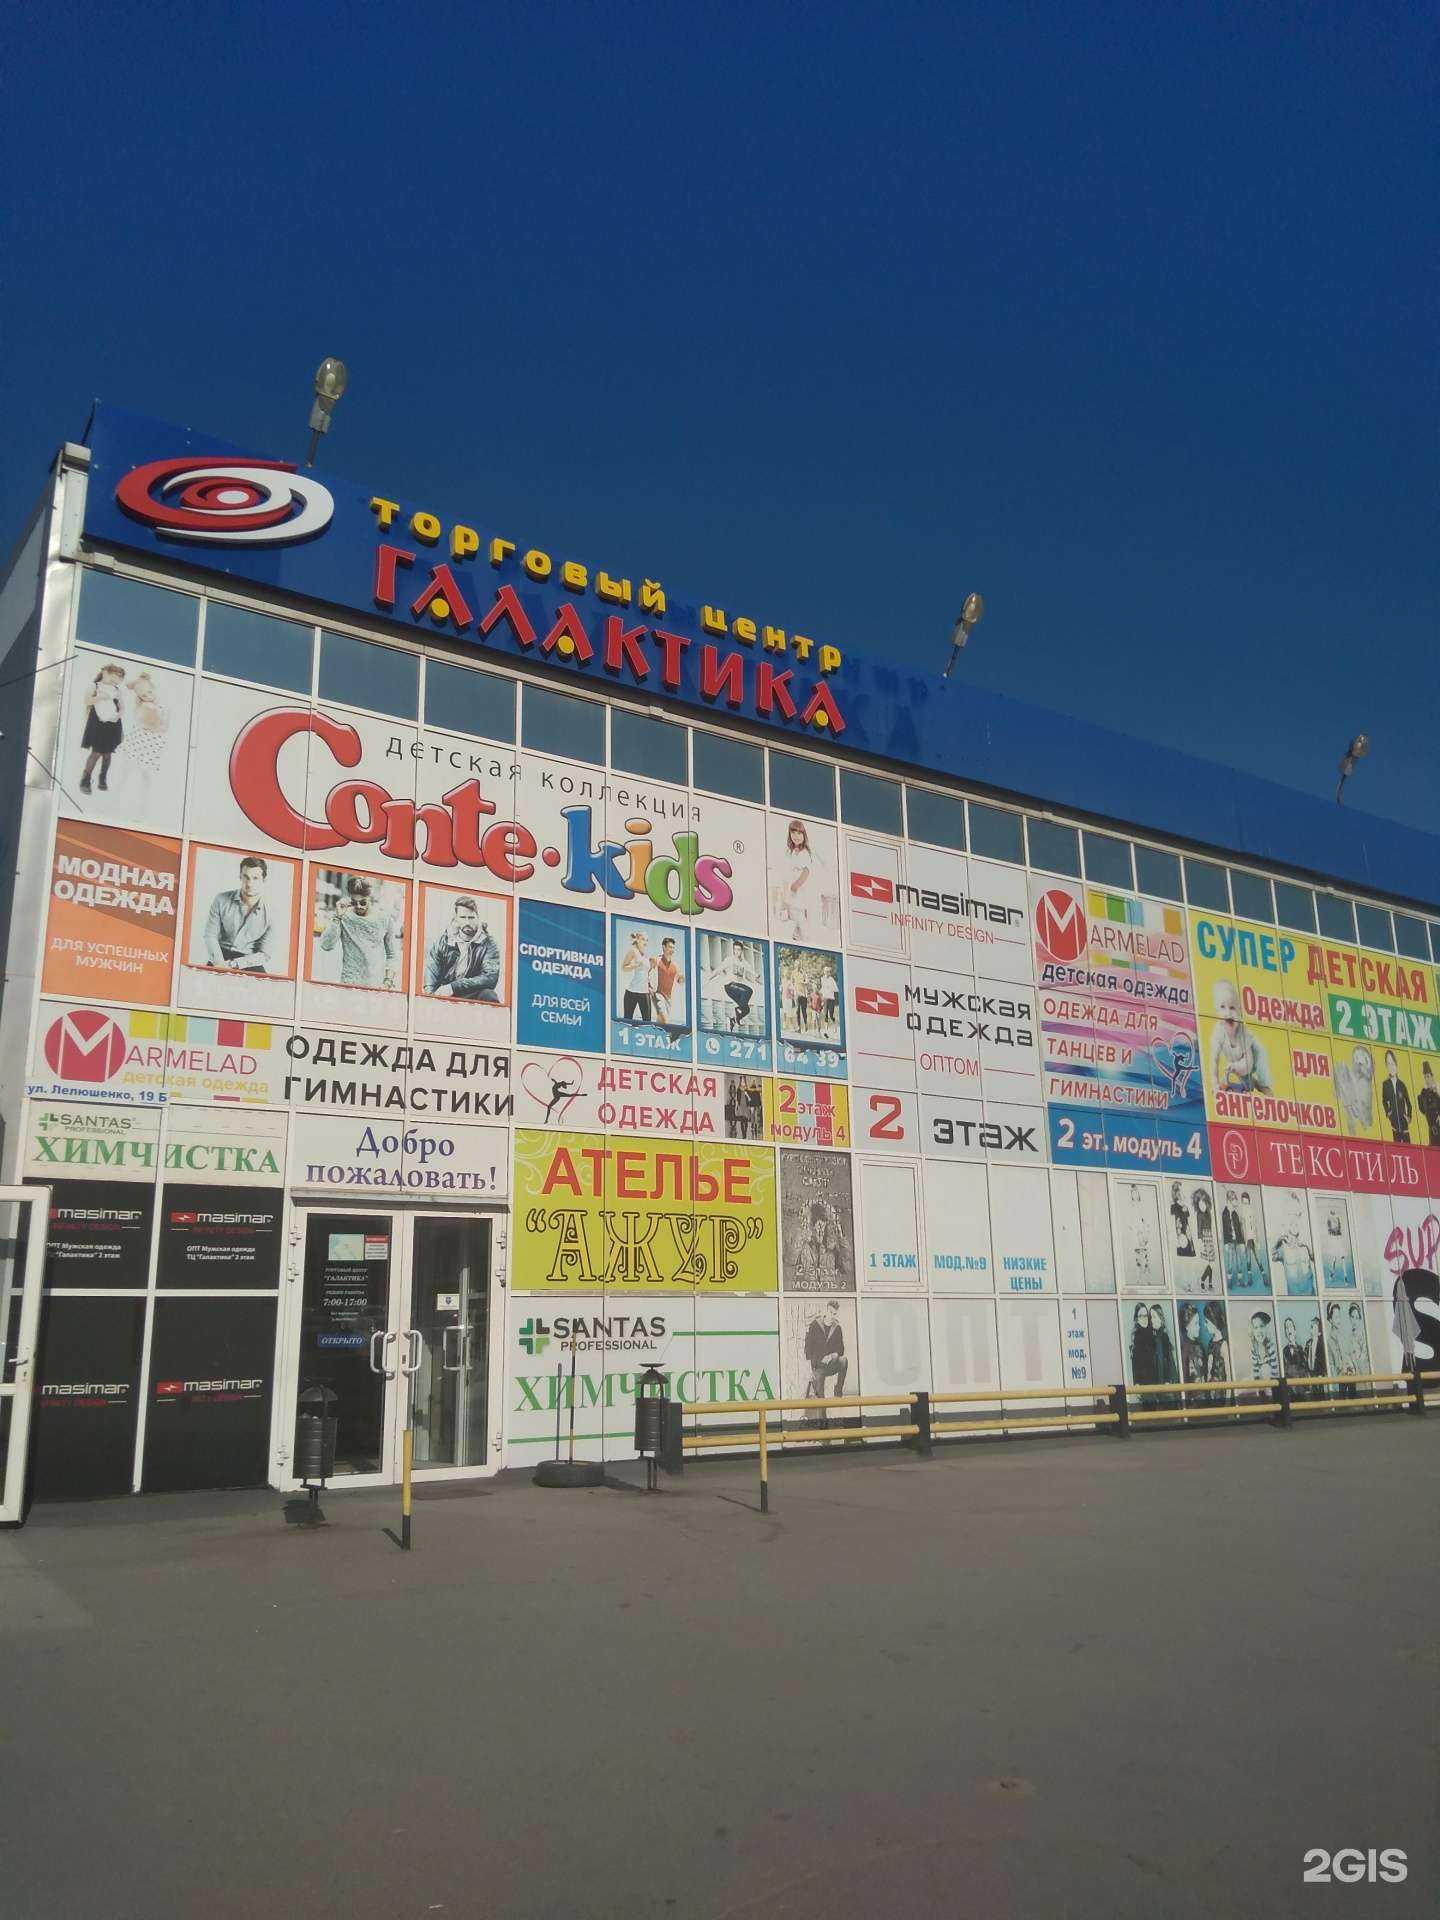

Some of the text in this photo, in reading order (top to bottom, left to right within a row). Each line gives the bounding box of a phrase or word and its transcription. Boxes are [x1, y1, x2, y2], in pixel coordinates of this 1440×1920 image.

[374, 544, 846, 735] ГАЛАКТИКА
[386, 734, 702, 822] детская коллекция
[57, 855, 176, 891] МОДНАЯ
[53, 880, 175, 916] ОДЕЖДА
[895, 884, 1024, 926] masimar
[890, 911, 995, 945] INFINITY DESIGN
[51, 938, 169, 963] ДЛЯ УСПЕШНЫХ
[519, 943, 604, 967] СПОРТИВНАЯ
[1196, 920, 1296, 973] СУПЕР
[75, 955, 144, 974] МУЖЧИН
[532, 960, 592, 980] ОДЕЖДА
[1307, 943, 1428, 1004] ДЕТСКАЯ
[1042, 964, 1190, 1004] детская одежда
[531, 994, 590, 1012] ДЛЯ ВСЕЙ
[1043, 998, 1159, 1031] ОДЕЖДА ДЛЯ
[1242, 986, 1325, 1029] Одежда
[541, 1010, 582, 1026] СЕМЬИ
[1336, 1000, 1437, 1051] 2 ЭТАЖ
[618, 1028, 629, 1046] 1
[729, 1040, 767, 1061] 271
[1047, 1037, 1132, 1064] ТАНЦЕВ И
[286, 1034, 510, 1079] ОДЕЖДА ДЛЯ
[919, 1053, 979, 1077] ОПТОМ
[1292, 1049, 1331, 1078] для
[27, 1084, 167, 1102] ул. Лелюшенко, 19 Б
[122, 1071, 269, 1094] детская одежда
[597, 1067, 717, 1098] ДЕТСКАЯ
[1049, 1078, 1169, 1110] ГИМНАСТИКИ
[284, 1076, 515, 1117] ГИМНАСТИКИ
[778, 1085, 837, 1118] 2 этаж
[1215, 1091, 1338, 1129] ангелочков
[59, 1114, 132, 1129] SANTAS
[597, 1103, 715, 1135] ОДЕЖДА
[869, 1094, 904, 1141] 2
[356, 1126, 455, 1163] Добро
[836, 1126, 846, 1140] 4
[1056, 1118, 1202, 1161] 2 эт. модуль 4
[32, 1135, 280, 1174] ХИМЧИСТКА
[305, 1164, 496, 1191] пожаловать!
[57, 1208, 142, 1220] masimar
[197, 1213, 274, 1224] masimar
[870, 1254, 917, 1268] 1 ЭТАЖ
[1003, 1257, 1047, 1271] НИЗКИЕ
[791, 1281, 838, 1292] МОДУЛЬ
[1010, 1277, 1043, 1291] ЦЕНЫ
[321, 1337, 363, 1345] ОТКРЫТО
[553, 1317, 666, 1339] SANTAS
[560, 1341, 657, 1352] PROFESSIONAL
[42, 1383, 130, 1395] masimar
[183, 1379, 263, 1391] masimar
